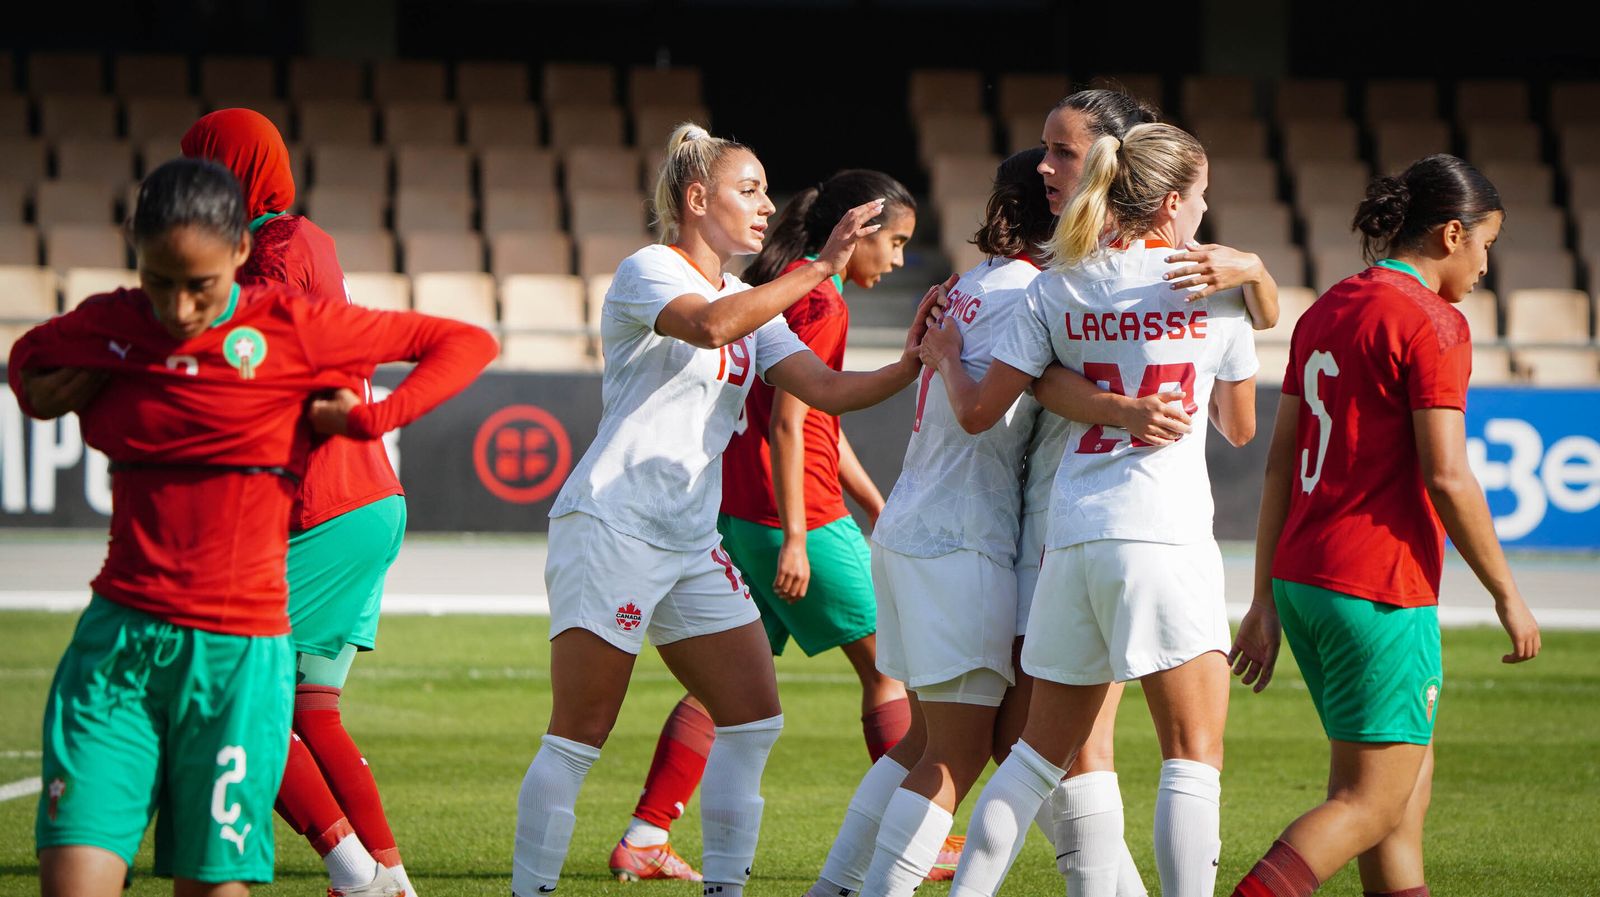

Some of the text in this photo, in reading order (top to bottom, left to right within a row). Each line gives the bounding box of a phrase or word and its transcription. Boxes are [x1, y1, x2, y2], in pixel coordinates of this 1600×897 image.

[1065, 311, 1208, 341] LACASSE
[716, 337, 751, 387] 19
[1301, 350, 1340, 495] 5
[616, 612, 641, 621] CANADA
[211, 745, 246, 825] 2
